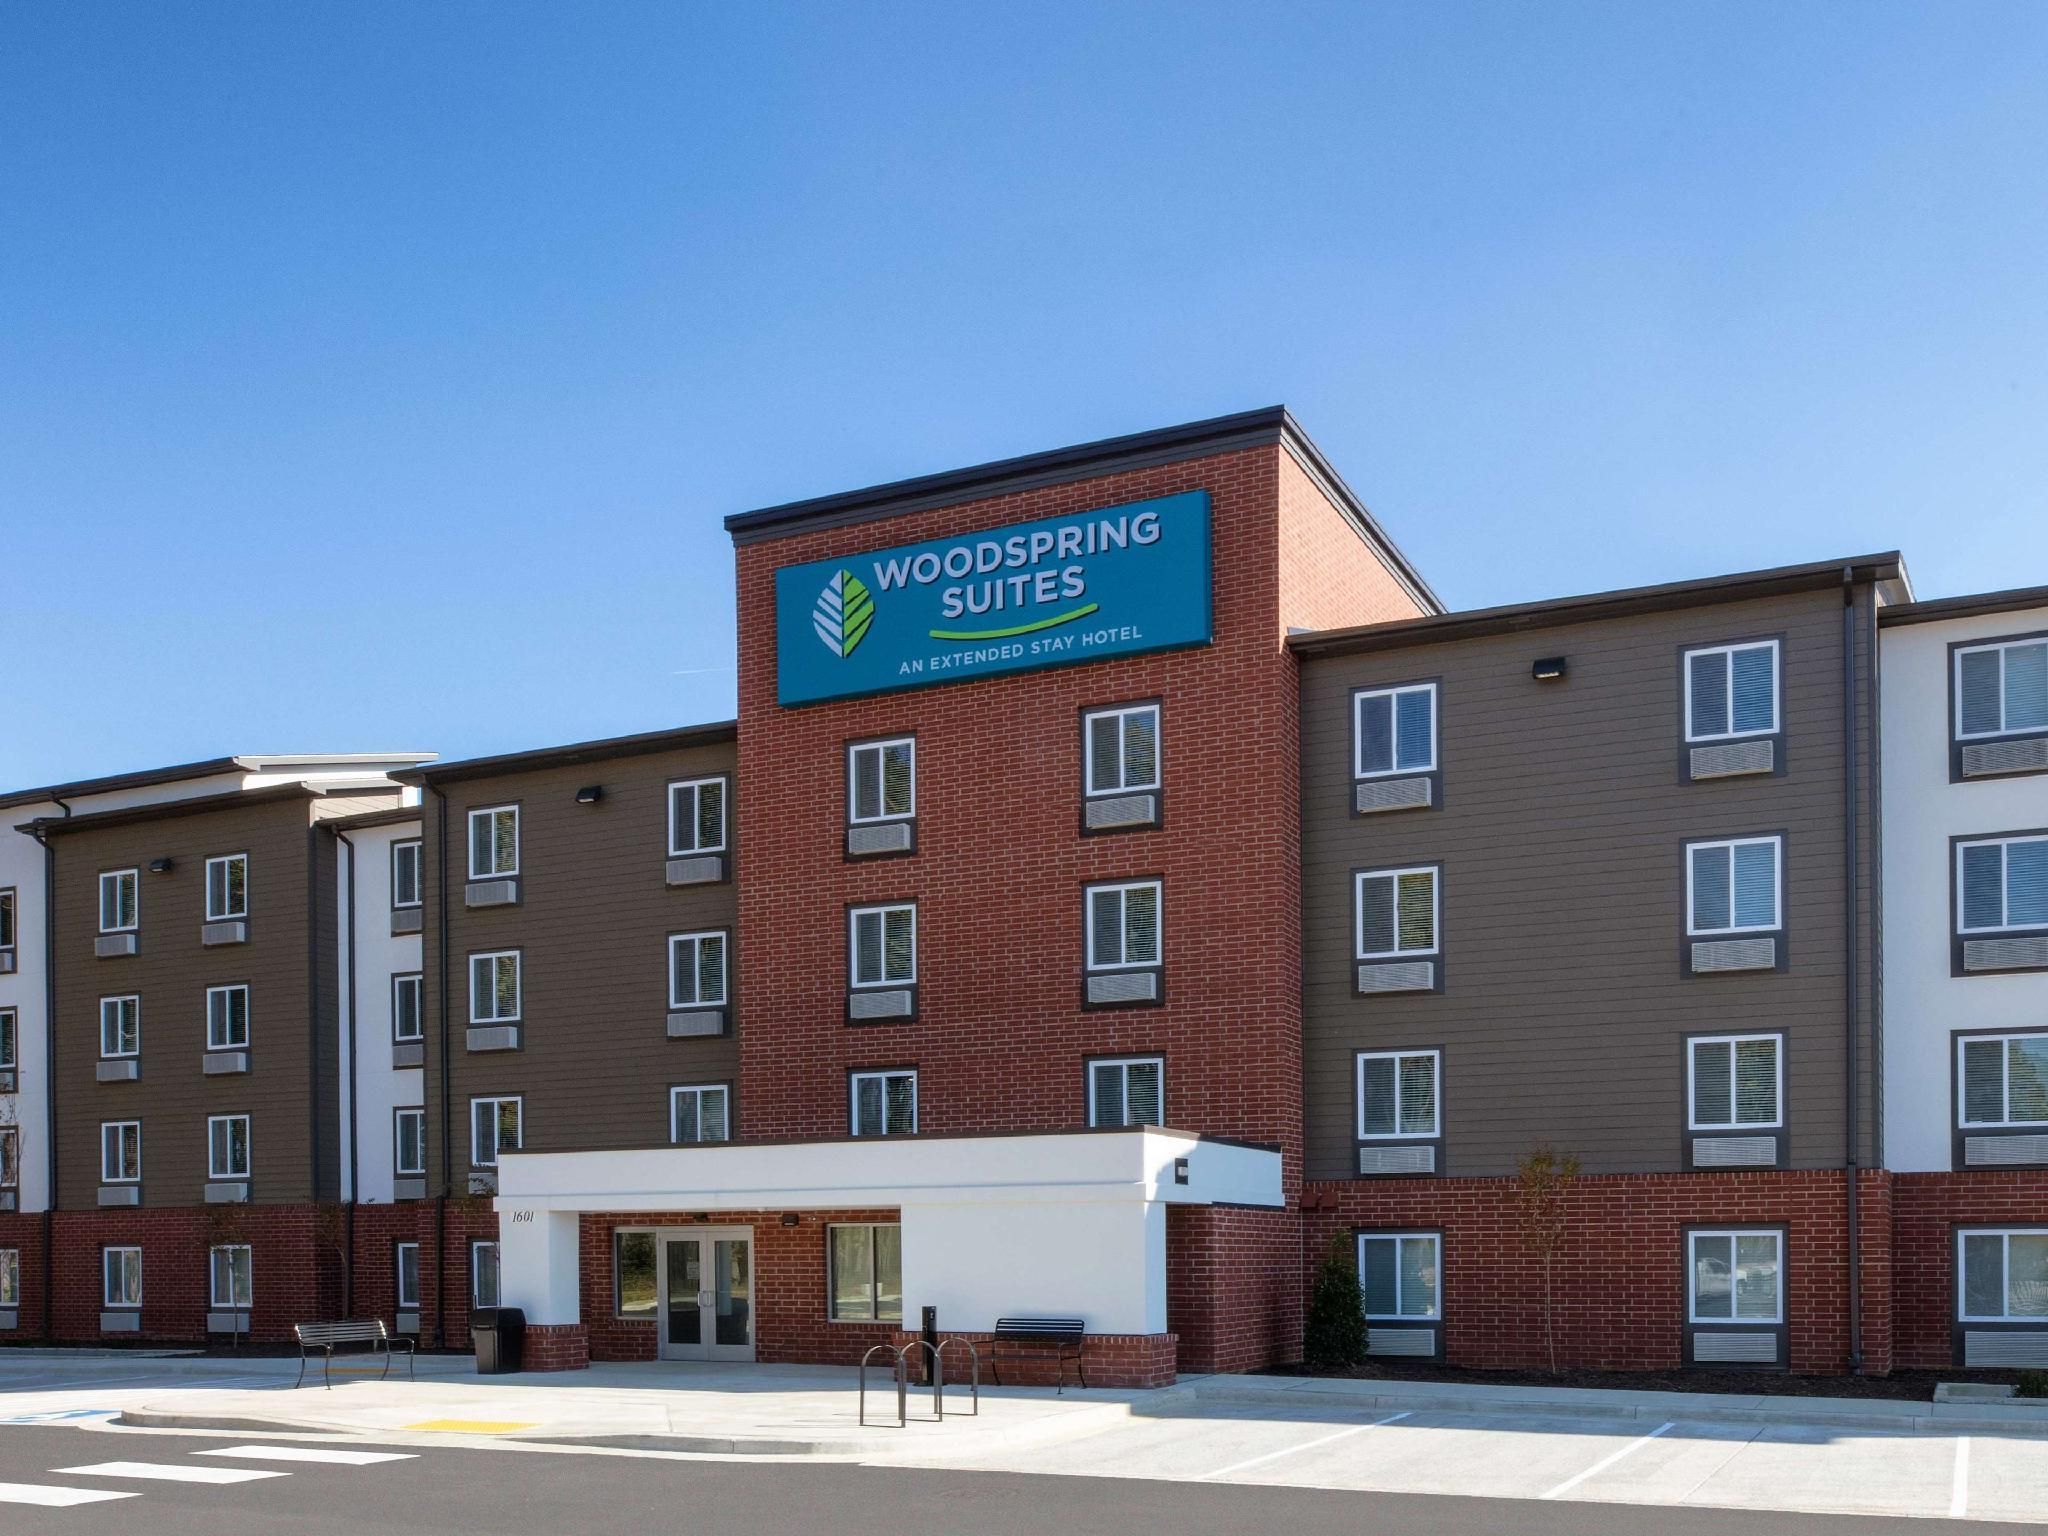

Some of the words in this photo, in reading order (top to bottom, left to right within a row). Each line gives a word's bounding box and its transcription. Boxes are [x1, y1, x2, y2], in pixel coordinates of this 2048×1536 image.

[873, 511, 1161, 591] WOODSPRING
[942, 565, 1086, 619] SUITES
[899, 659, 923, 675] AN
[931, 643, 1024, 670] EXTENDED
[1031, 635, 1075, 655] STAY
[1082, 626, 1143, 646] HOTEL
[512, 1211, 534, 1223] 1601
